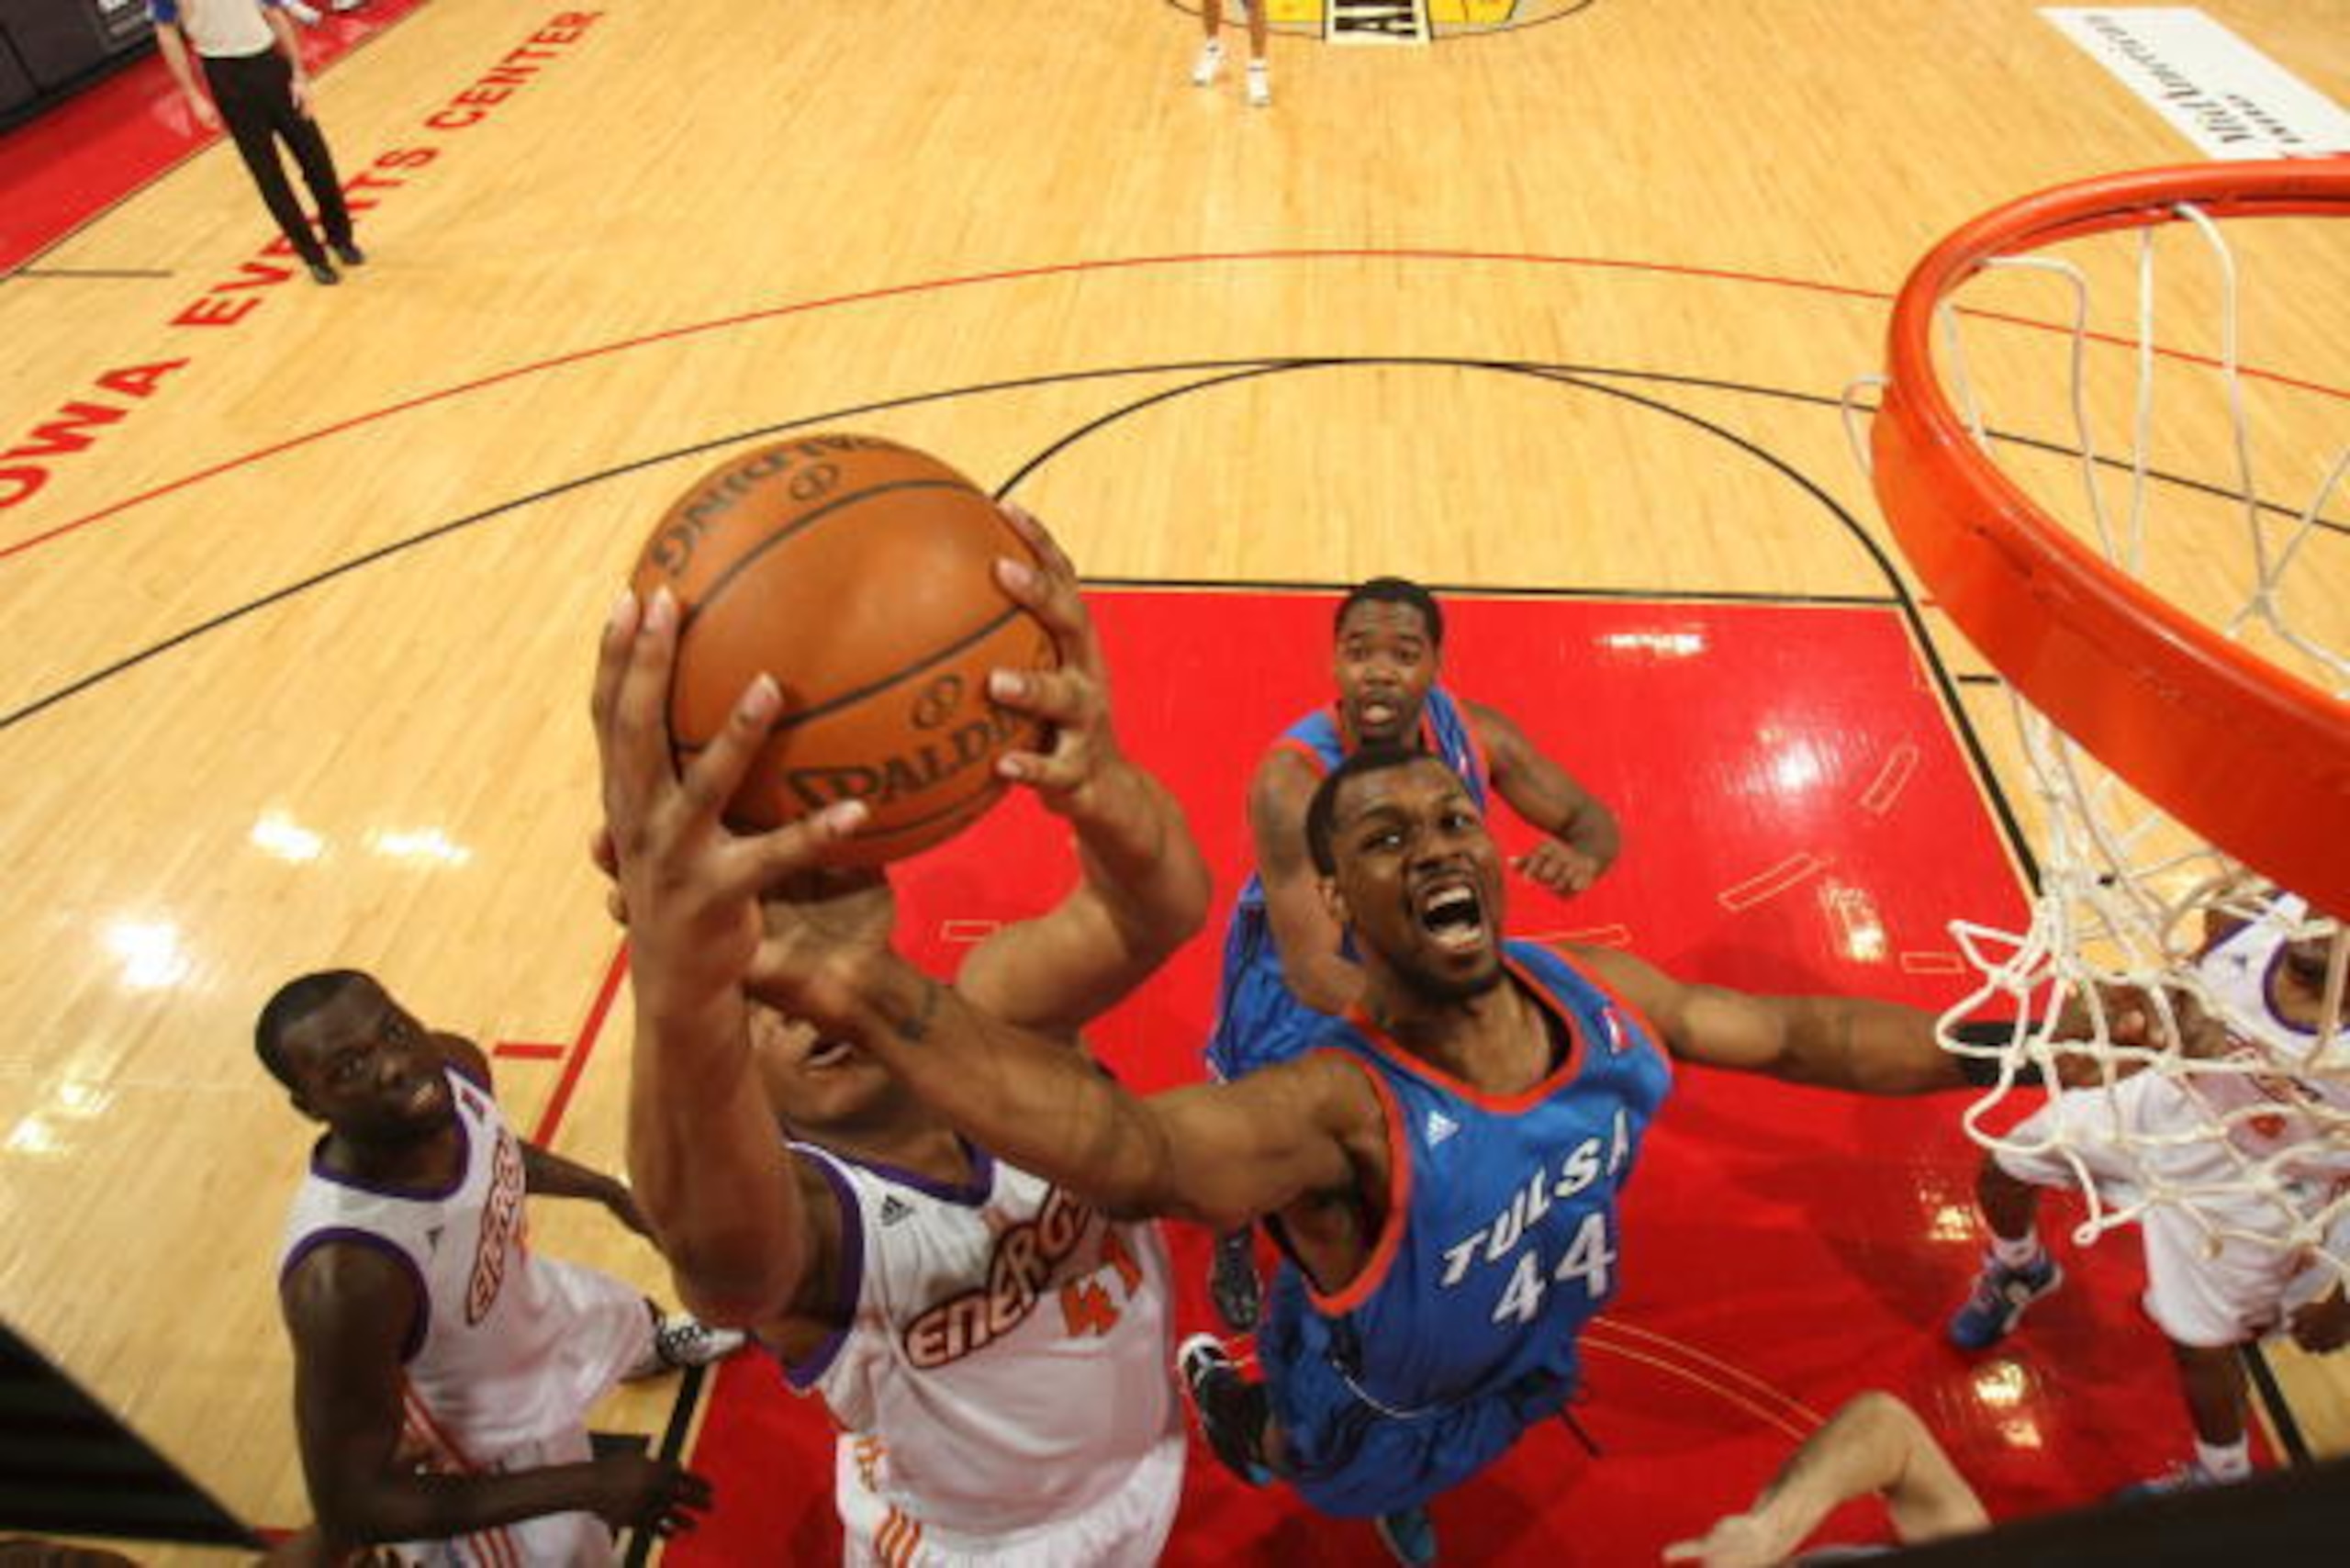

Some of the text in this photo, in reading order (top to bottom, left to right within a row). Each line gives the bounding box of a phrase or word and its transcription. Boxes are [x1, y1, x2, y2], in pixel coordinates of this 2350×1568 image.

[423, 11, 605, 128] CENTER
[905, 1180, 1094, 1369] ENERG
[1491, 1212, 1617, 1326] 44
